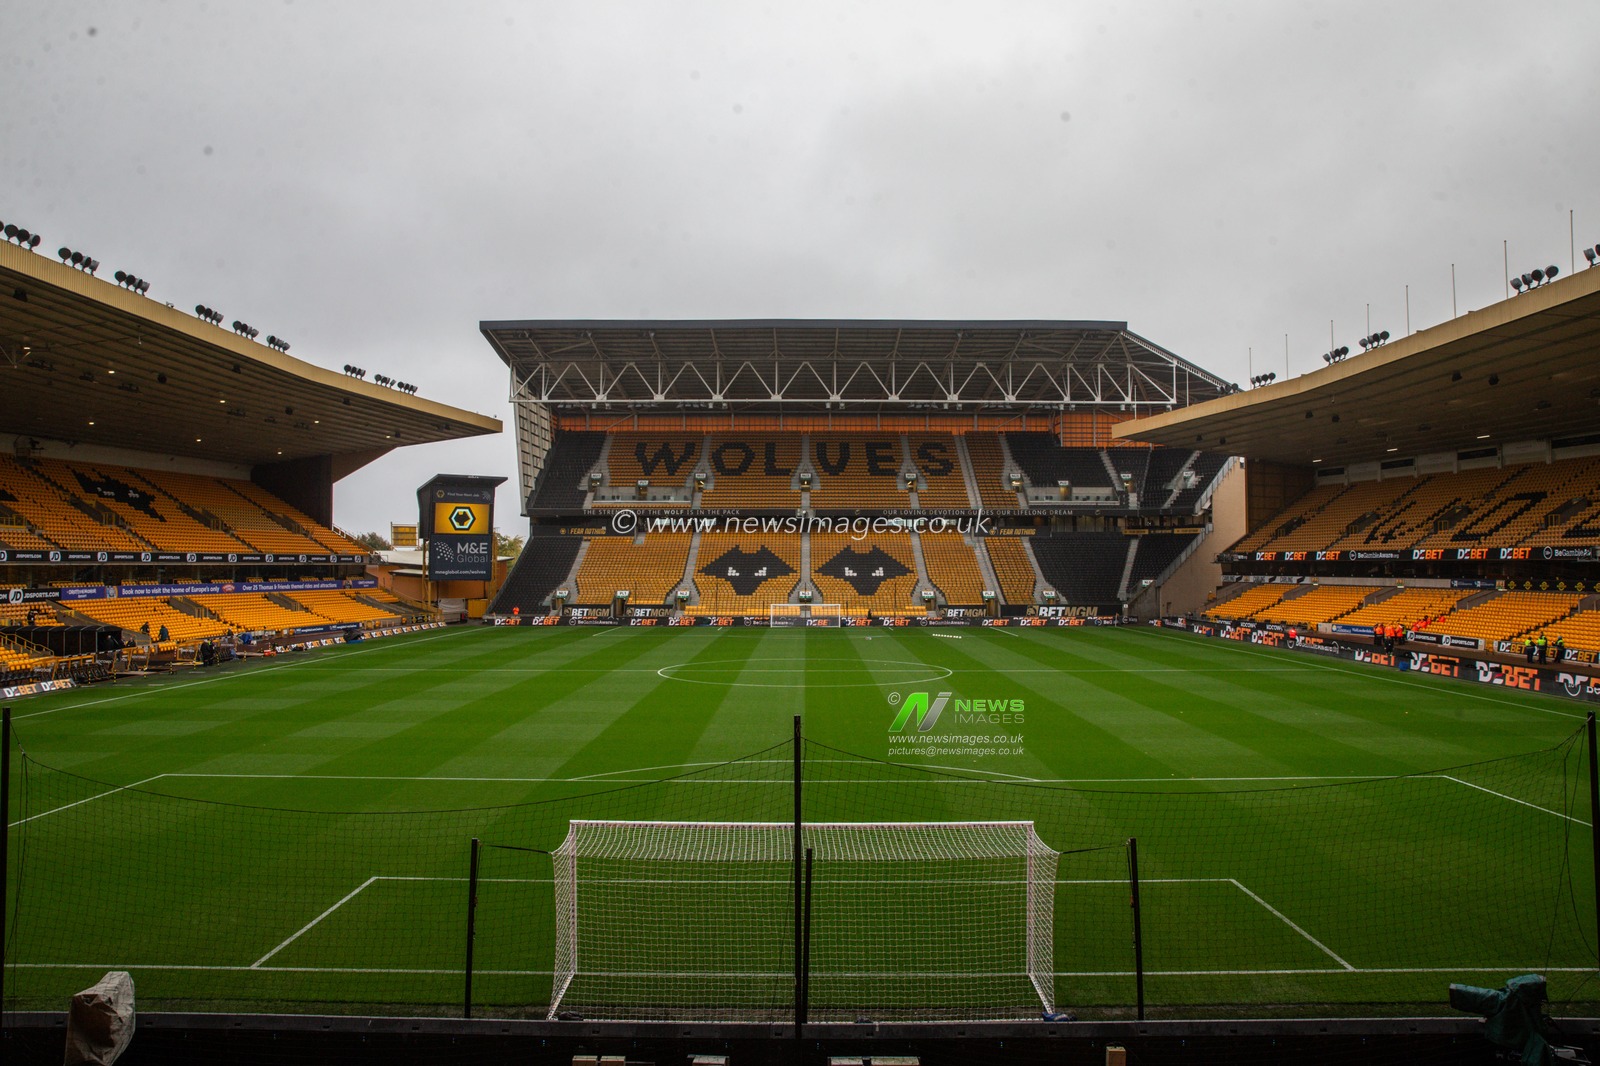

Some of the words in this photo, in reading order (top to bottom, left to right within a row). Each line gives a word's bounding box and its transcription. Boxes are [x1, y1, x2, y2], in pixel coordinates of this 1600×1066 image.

[634, 441, 955, 477] WOLVES
[457, 542, 488, 554] M&E
[457, 554, 488, 563] Global
[191, 585, 210, 593] Europe's
[210, 584, 220, 592] only
[24, 591, 59, 599] JDSPORTS.COM
[571, 608, 610, 616] BETMGM
[634, 608, 673, 617] BETMGM
[947, 608, 987, 617] BETMGM
